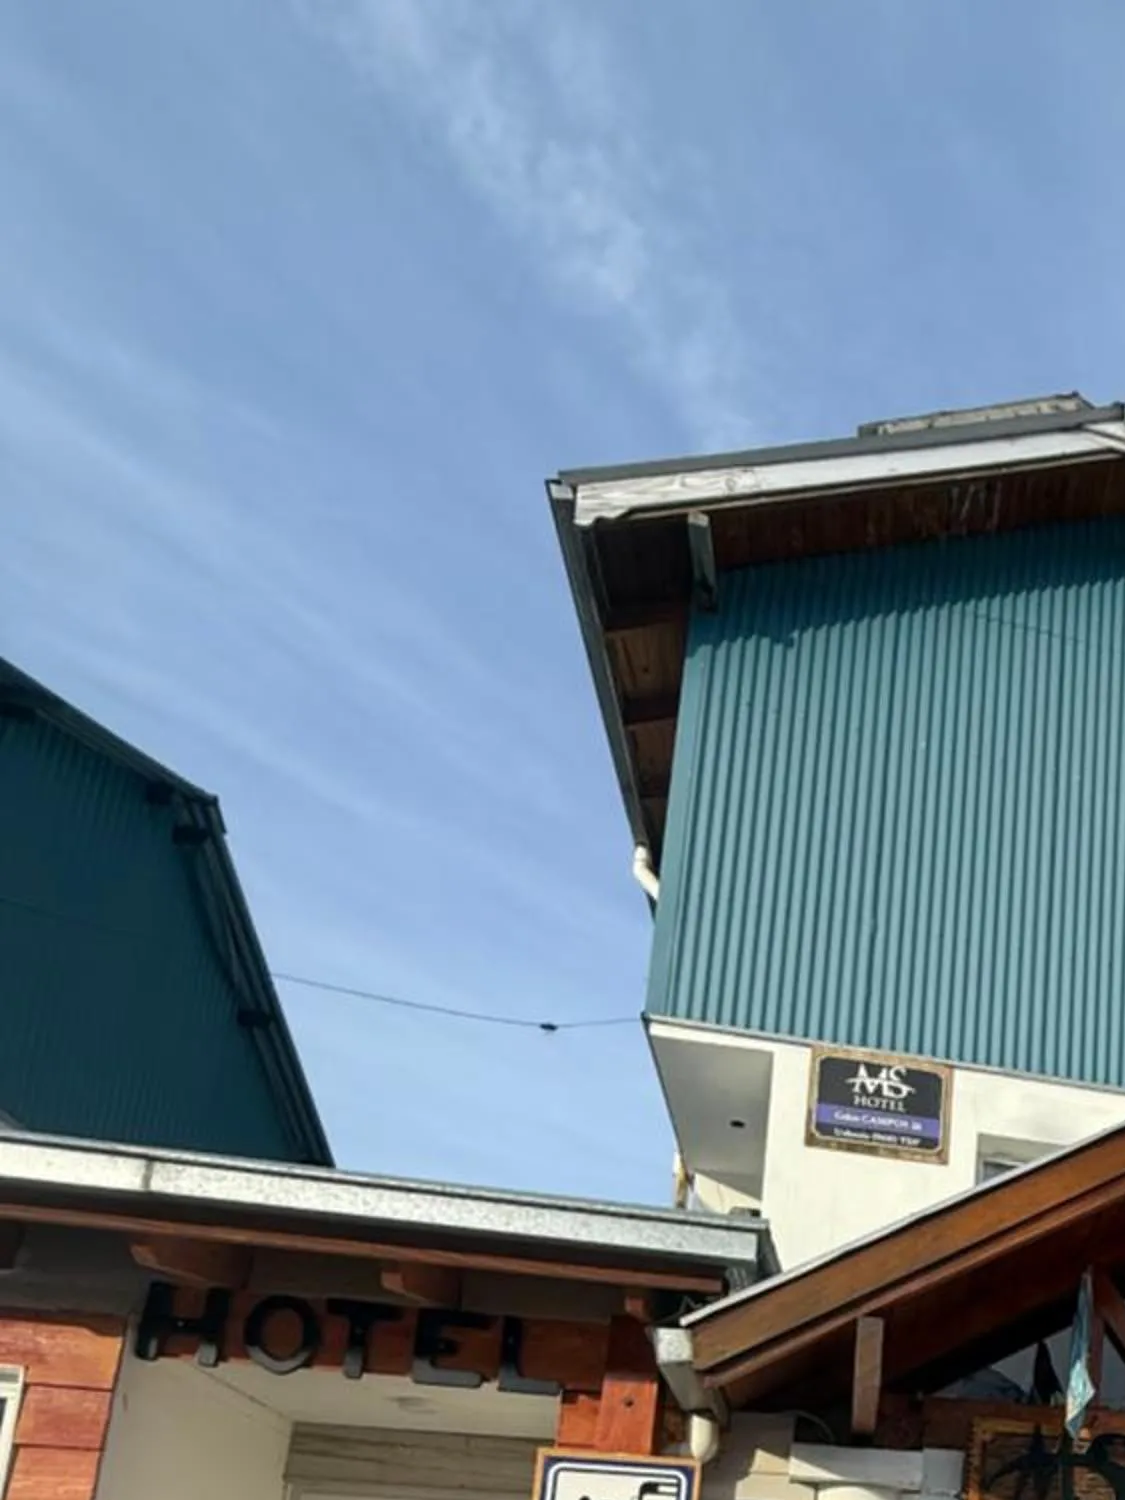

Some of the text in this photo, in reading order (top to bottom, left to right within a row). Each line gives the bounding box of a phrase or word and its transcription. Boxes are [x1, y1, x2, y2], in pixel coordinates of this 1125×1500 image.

[845, 1063, 916, 1099] MS
[853, 1094, 906, 1113] HOTEL
[134, 1281, 561, 1395] HOTEL
